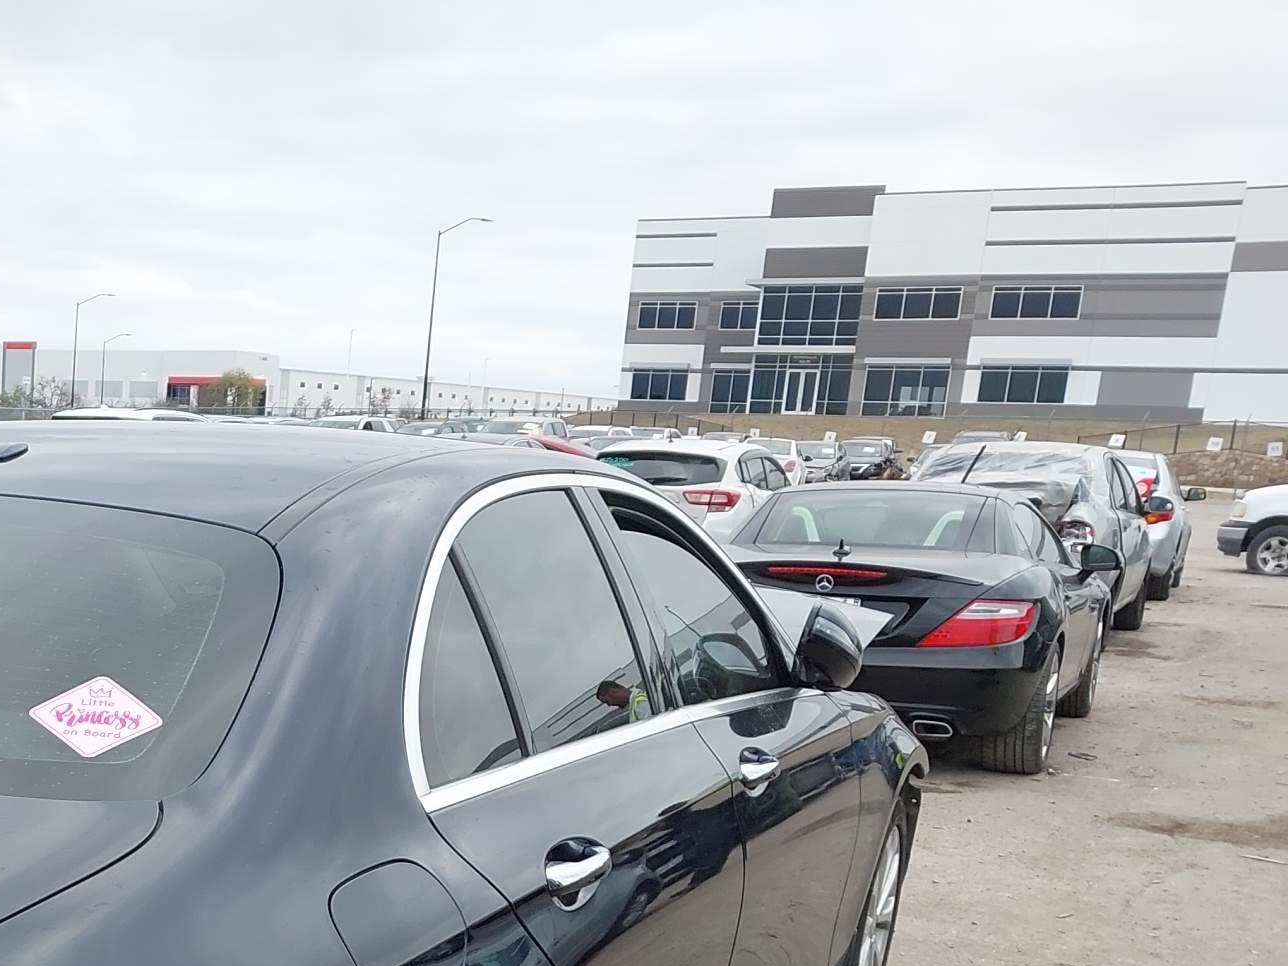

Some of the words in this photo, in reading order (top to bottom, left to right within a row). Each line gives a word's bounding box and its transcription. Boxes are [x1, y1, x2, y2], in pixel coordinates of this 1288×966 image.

[80, 698, 116, 708] Little
[50, 702, 142, 730] Princess
[62, 728, 78, 736] on
[83, 729, 122, 739] Board
